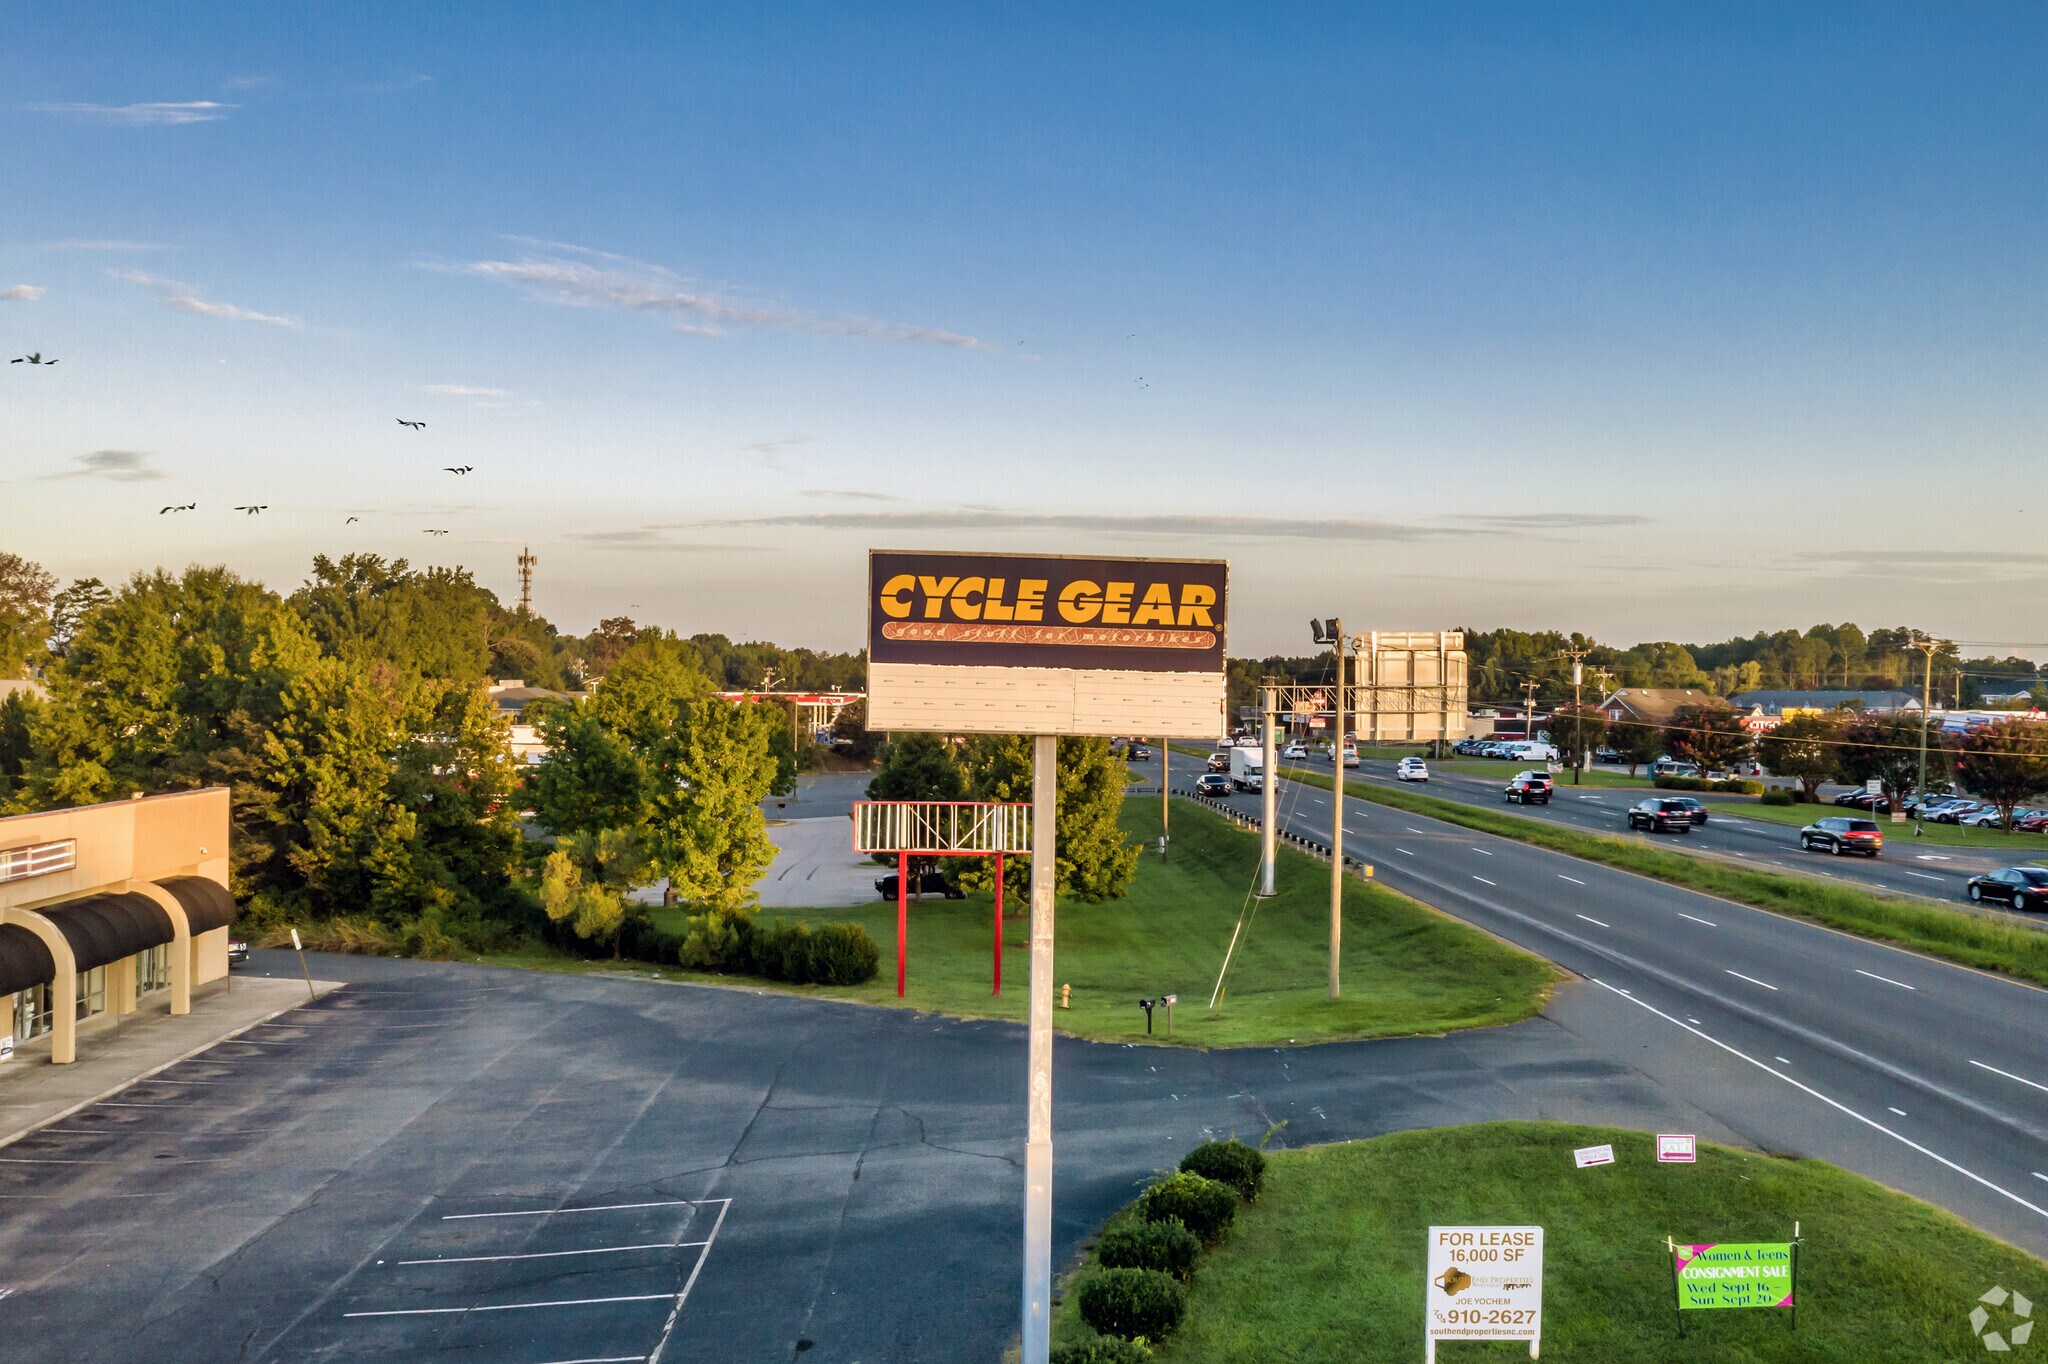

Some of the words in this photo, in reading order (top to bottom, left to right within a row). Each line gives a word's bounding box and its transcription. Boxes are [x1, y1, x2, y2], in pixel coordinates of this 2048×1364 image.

[880, 574, 1048, 621] CYCLE
[1057, 579, 1217, 627] GEAR
[896, 626, 947, 637] good
[963, 628, 1019, 640] stuff
[1033, 628, 1065, 641] for
[1082, 631, 1203, 645] motorbikes
[820, 697, 841, 705] EXXON
[1661, 1144, 1691, 1152] SALE
[1439, 1233, 1474, 1246] FOR
[1480, 1233, 1535, 1246] LEASE
[1449, 1249, 1498, 1263] 16,000
[1503, 1248, 1525, 1262] SF
[1697, 1250, 1741, 1261] Women
[1744, 1250, 1753, 1261] &
[1757, 1249, 1789, 1260] Teens
[1682, 1266, 1760, 1279] CONSIGNMENT
[1762, 1265, 1789, 1278] SALE
[1687, 1283, 1716, 1293] Wed
[1722, 1283, 1751, 1294] Sept
[1757, 1282, 1770, 1292] 16
[1690, 1296, 1715, 1305] Sun
[1722, 1295, 1751, 1306] Sept
[1756, 1294, 1772, 1304] 20
[1447, 1309, 1537, 1324] 910-2627
[1430, 1328, 1535, 1336] southendpropertiesnc.com
